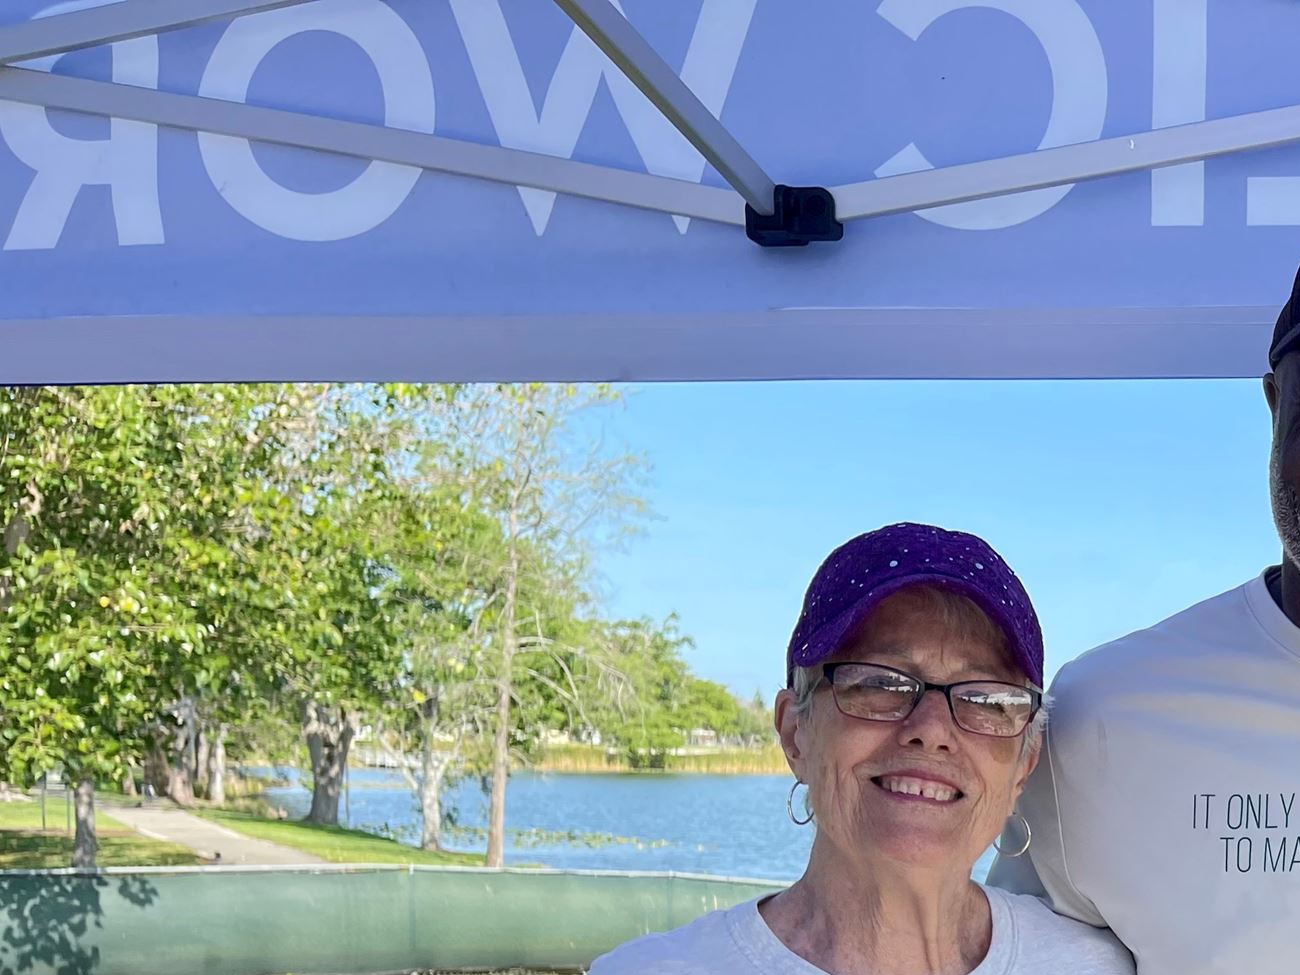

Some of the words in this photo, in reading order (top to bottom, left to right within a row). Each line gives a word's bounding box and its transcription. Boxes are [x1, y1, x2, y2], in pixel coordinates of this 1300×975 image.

[1192, 793, 1215, 829] IT
[1226, 792, 1296, 830] ONLY
[1220, 836, 1253, 873] TO
